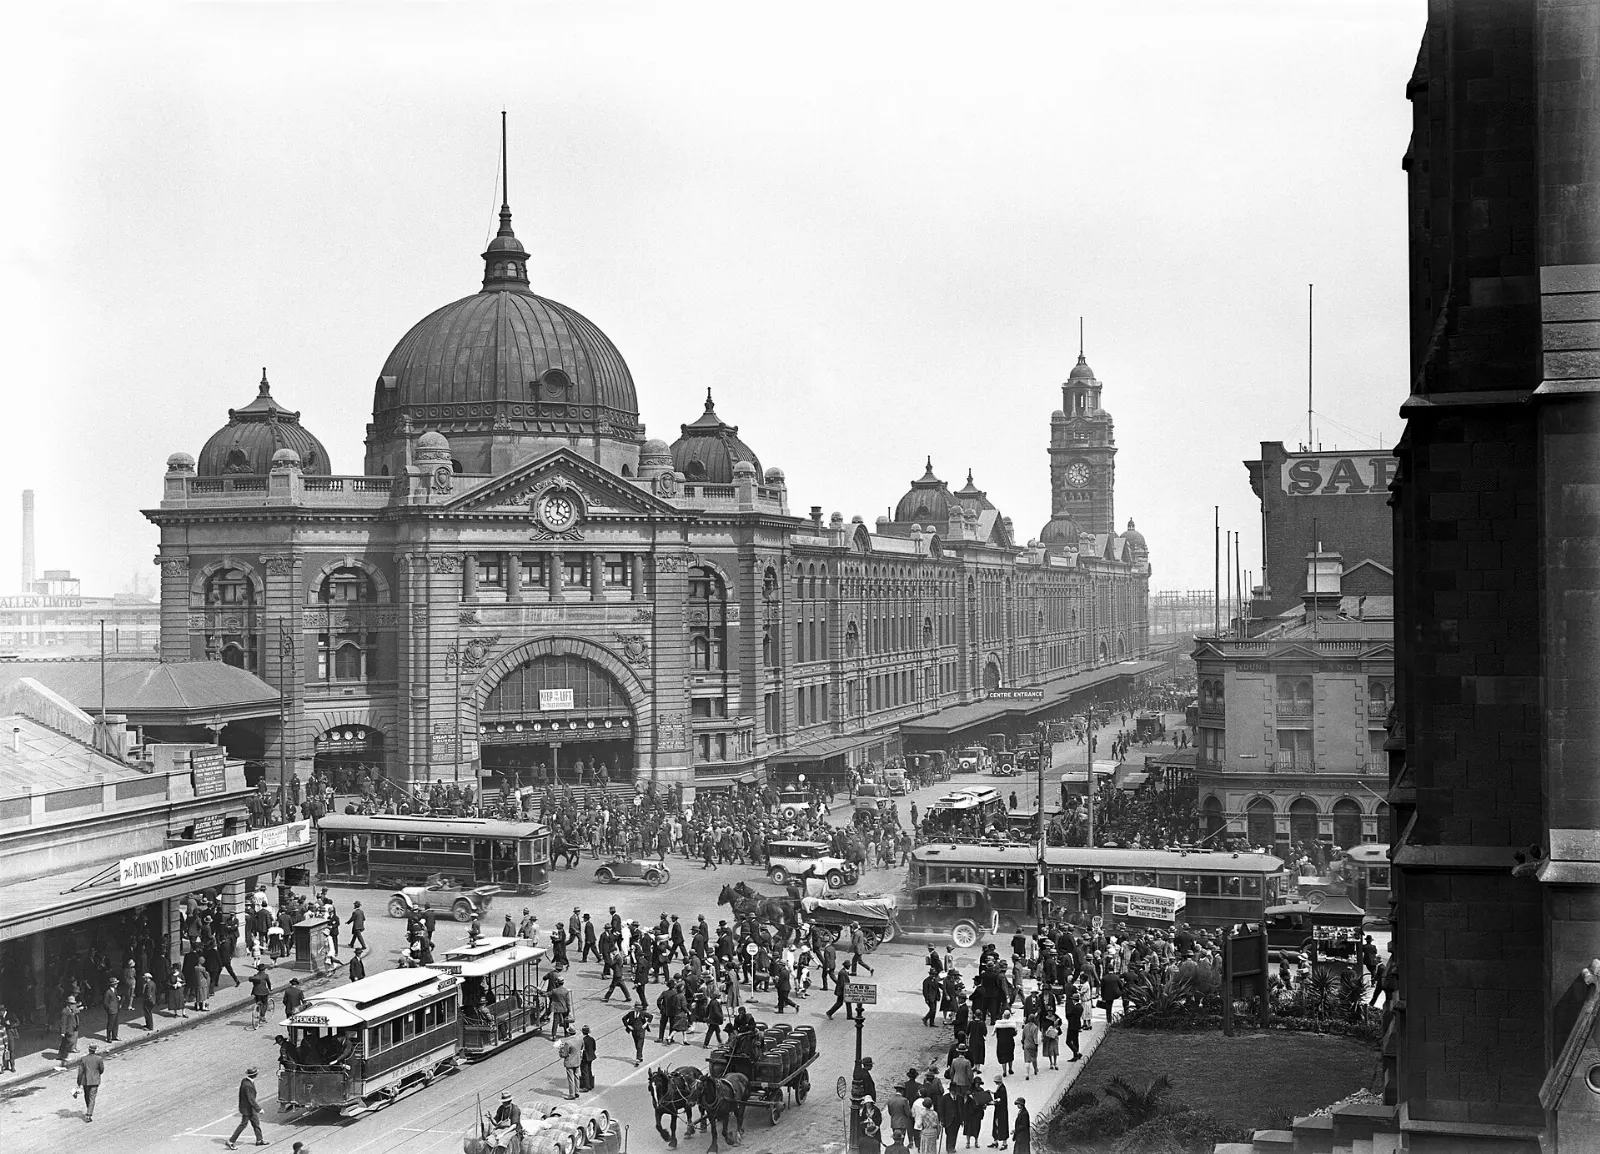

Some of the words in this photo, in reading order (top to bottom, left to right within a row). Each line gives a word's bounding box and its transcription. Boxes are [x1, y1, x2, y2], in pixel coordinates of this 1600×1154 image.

[44, 596, 82, 608] LIMITED
[540, 691, 552, 701] KEEP
[560, 690, 572, 701] LEFT
[134, 858, 160, 878] RAILWAY
[162, 855, 174, 872] BUS
[175, 852, 182, 869] TO
[182, 847, 208, 867] GEELONG
[210, 842, 230, 862] STARTS
[232, 836, 258, 856] OPPOSITE
[1156, 898, 1174, 908] MARSH
[1162, 906, 1174, 914] MILK
[303, 1084, 314, 1094] 17
